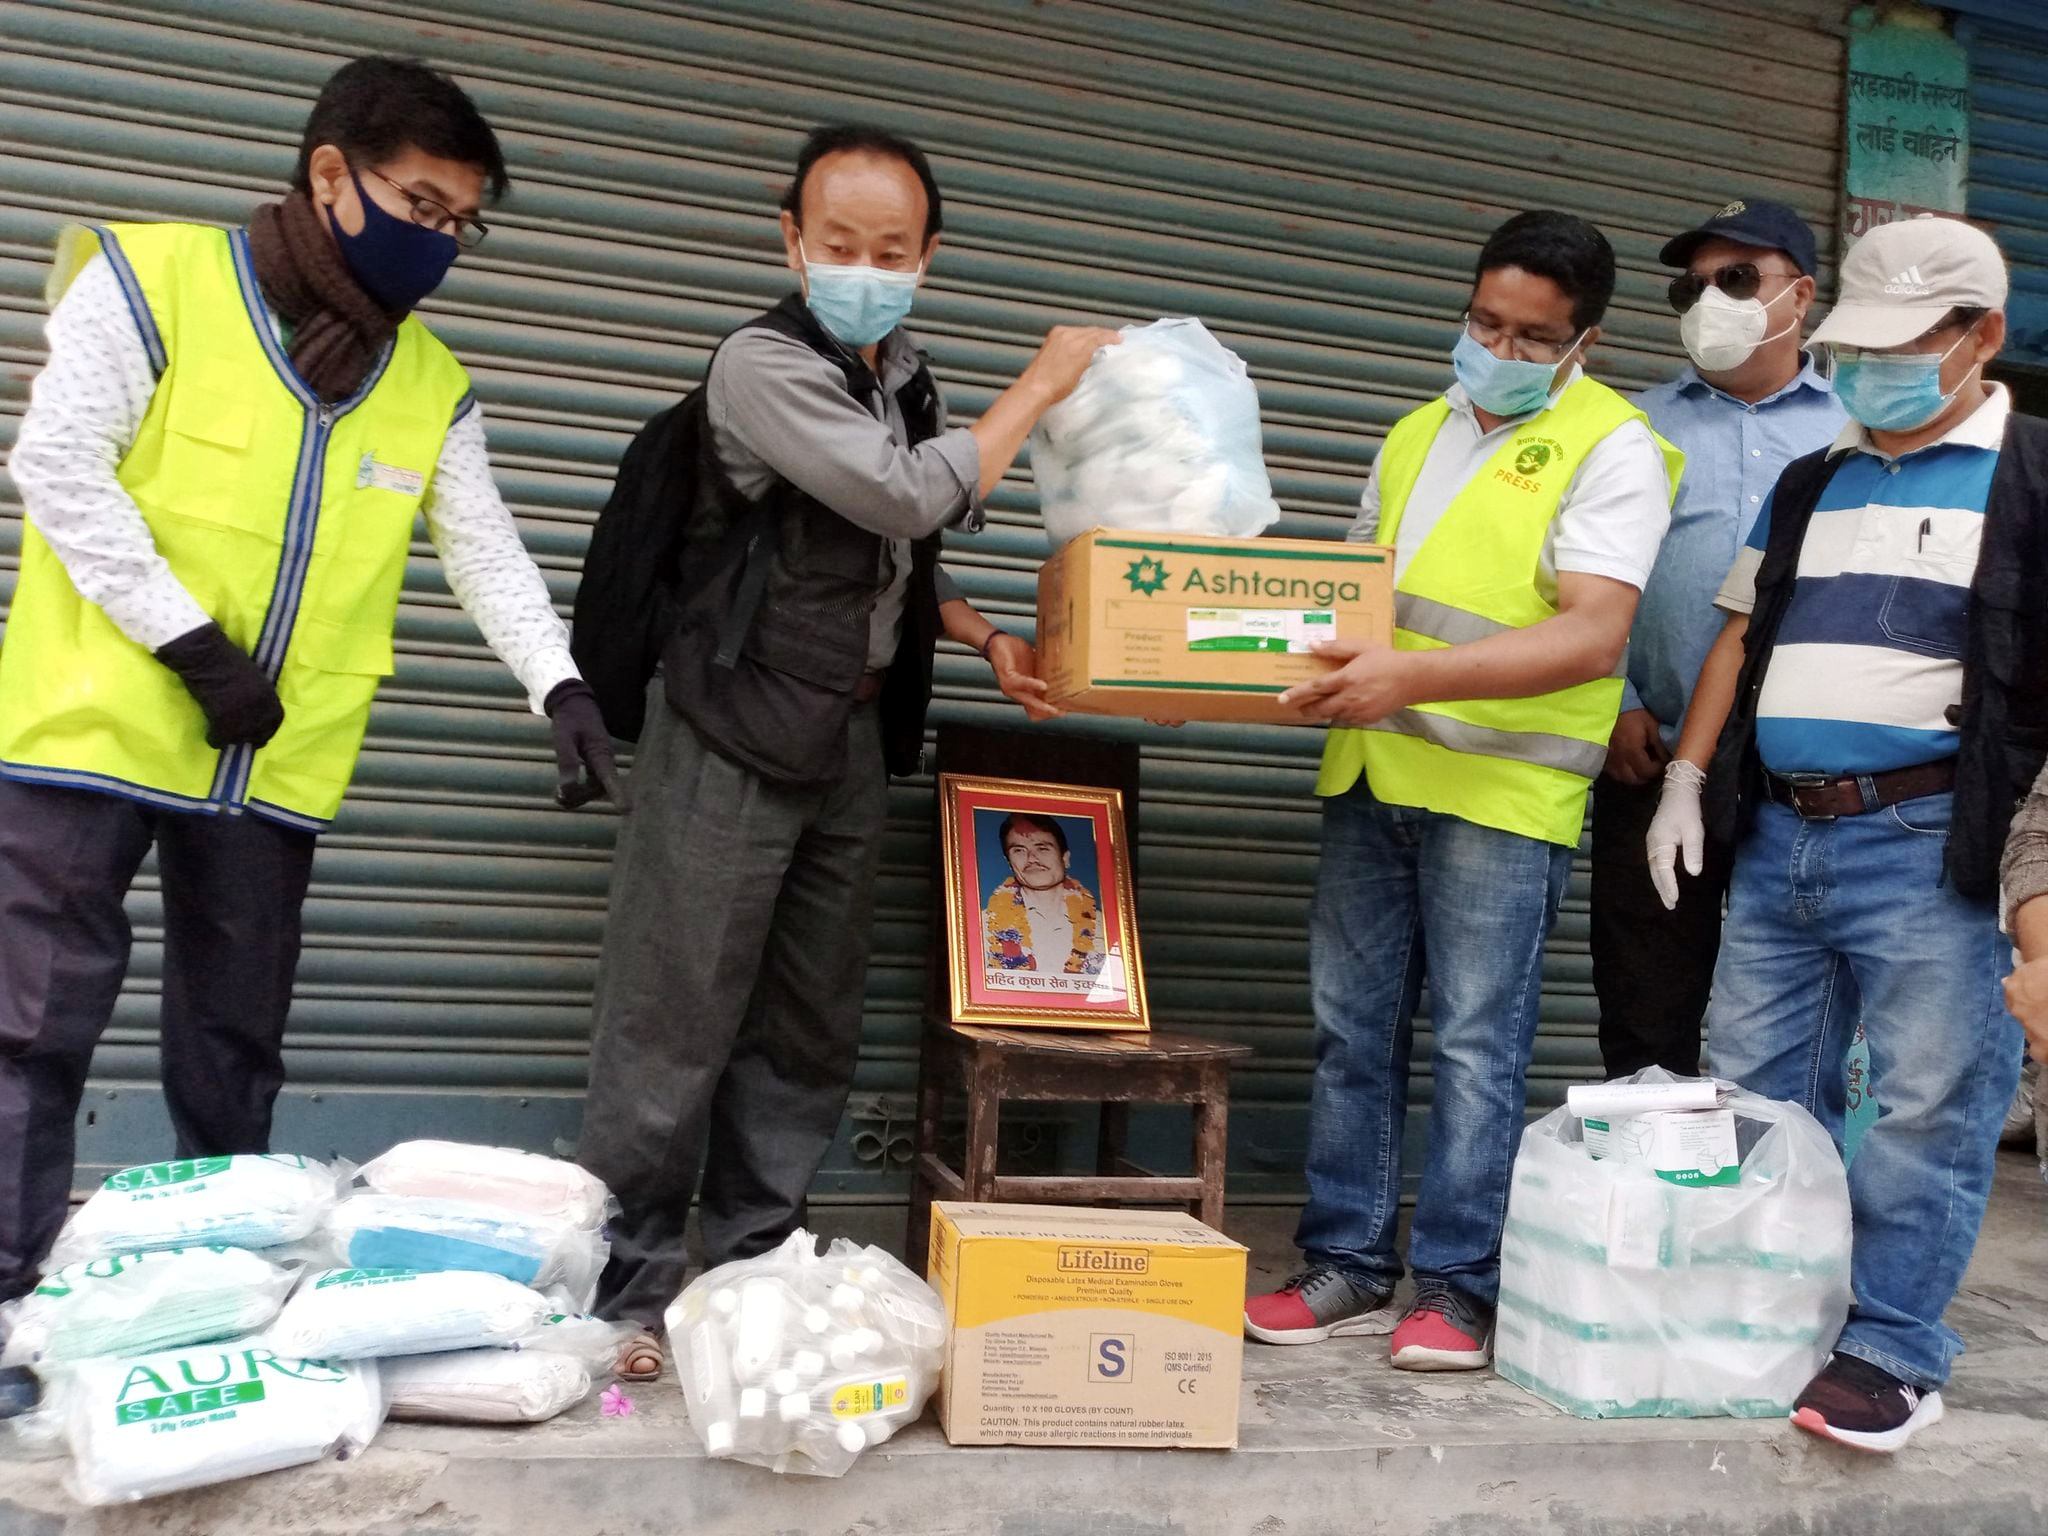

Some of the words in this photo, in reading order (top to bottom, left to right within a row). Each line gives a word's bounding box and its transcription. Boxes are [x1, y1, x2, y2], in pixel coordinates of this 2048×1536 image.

[1494, 468, 1542, 494] PRESS
[1182, 567, 1361, 606] Ashtanga
[986, 972, 1014, 986] सहिद
[1019, 975, 1045, 989] कृष्ण
[1050, 976, 1068, 988] सेन
[112, 1158, 210, 1191] SAFE
[1060, 1250, 1146, 1271] Lifeline
[1026, 1276, 1064, 1284] Disposable
[1116, 1278, 1158, 1286] Examination
[1160, 1280, 1183, 1288] Gloves
[1109, 1287, 1133, 1296] Quality
[1098, 1339, 1125, 1377] S
[1165, 1352, 1176, 1361] ISO
[1178, 1352, 1191, 1361] 9001
[1197, 1352, 1212, 1361] 2015
[1165, 1363, 1181, 1373] (QMS
[1183, 1363, 1211, 1374] Certified)
[126, 1385, 240, 1421] SAFE
[982, 1405, 1015, 1413] Quantity
[181, 1416, 206, 1428] Face
[1023, 1418, 1040, 1427] This
[1042, 1419, 1072, 1429] product
[1005, 1431, 1022, 1439] may
[1050, 1430, 1078, 1439] allergic
[1151, 1430, 1193, 1439] individuals
